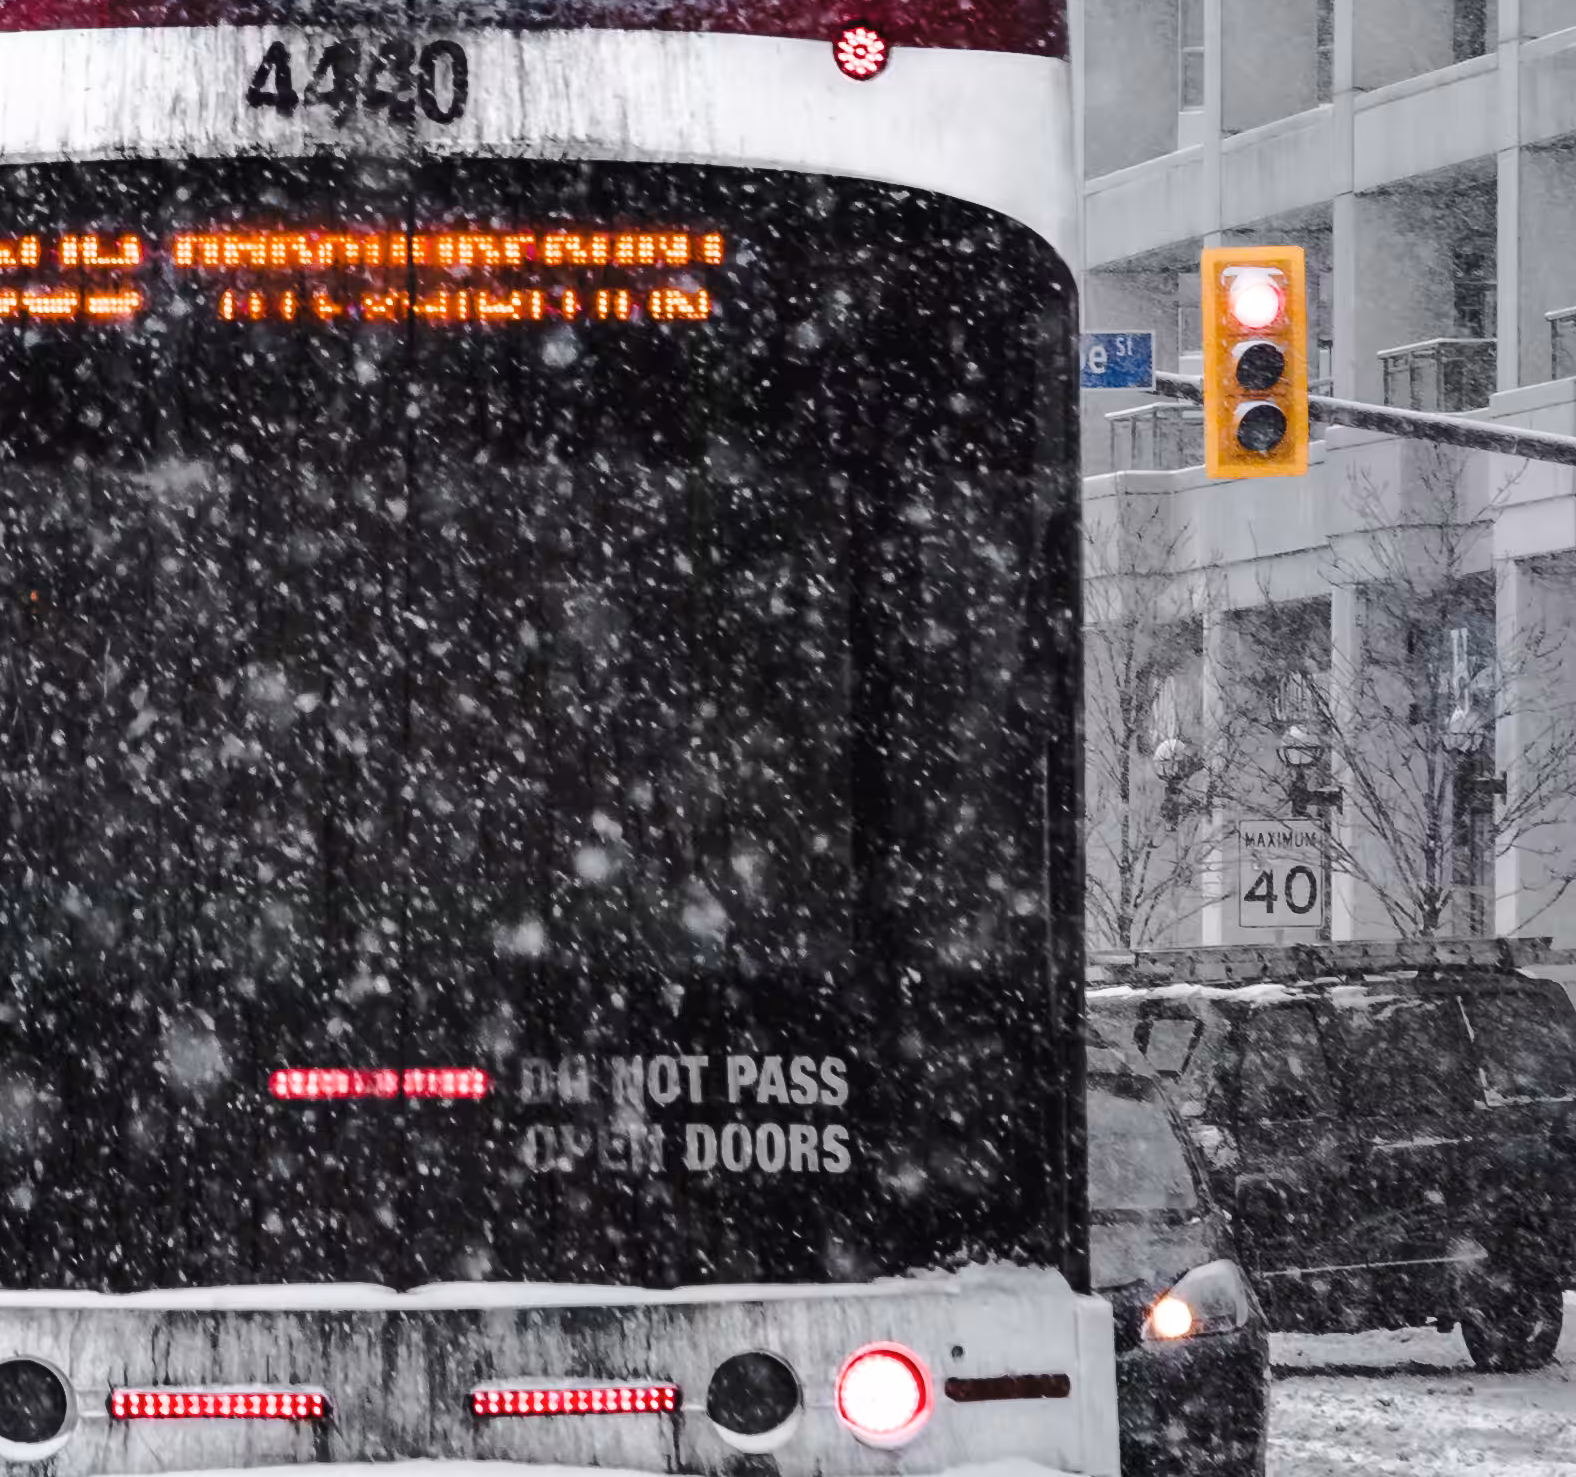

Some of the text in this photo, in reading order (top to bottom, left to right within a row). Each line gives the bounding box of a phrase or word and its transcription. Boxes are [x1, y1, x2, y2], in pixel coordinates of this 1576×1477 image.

[1245, 831, 1316, 848] MAXIMUM
[1244, 865, 1317, 914] 40
[519, 1055, 849, 1106] DO NOT PASS
[684, 1123, 851, 1173] DOORS
